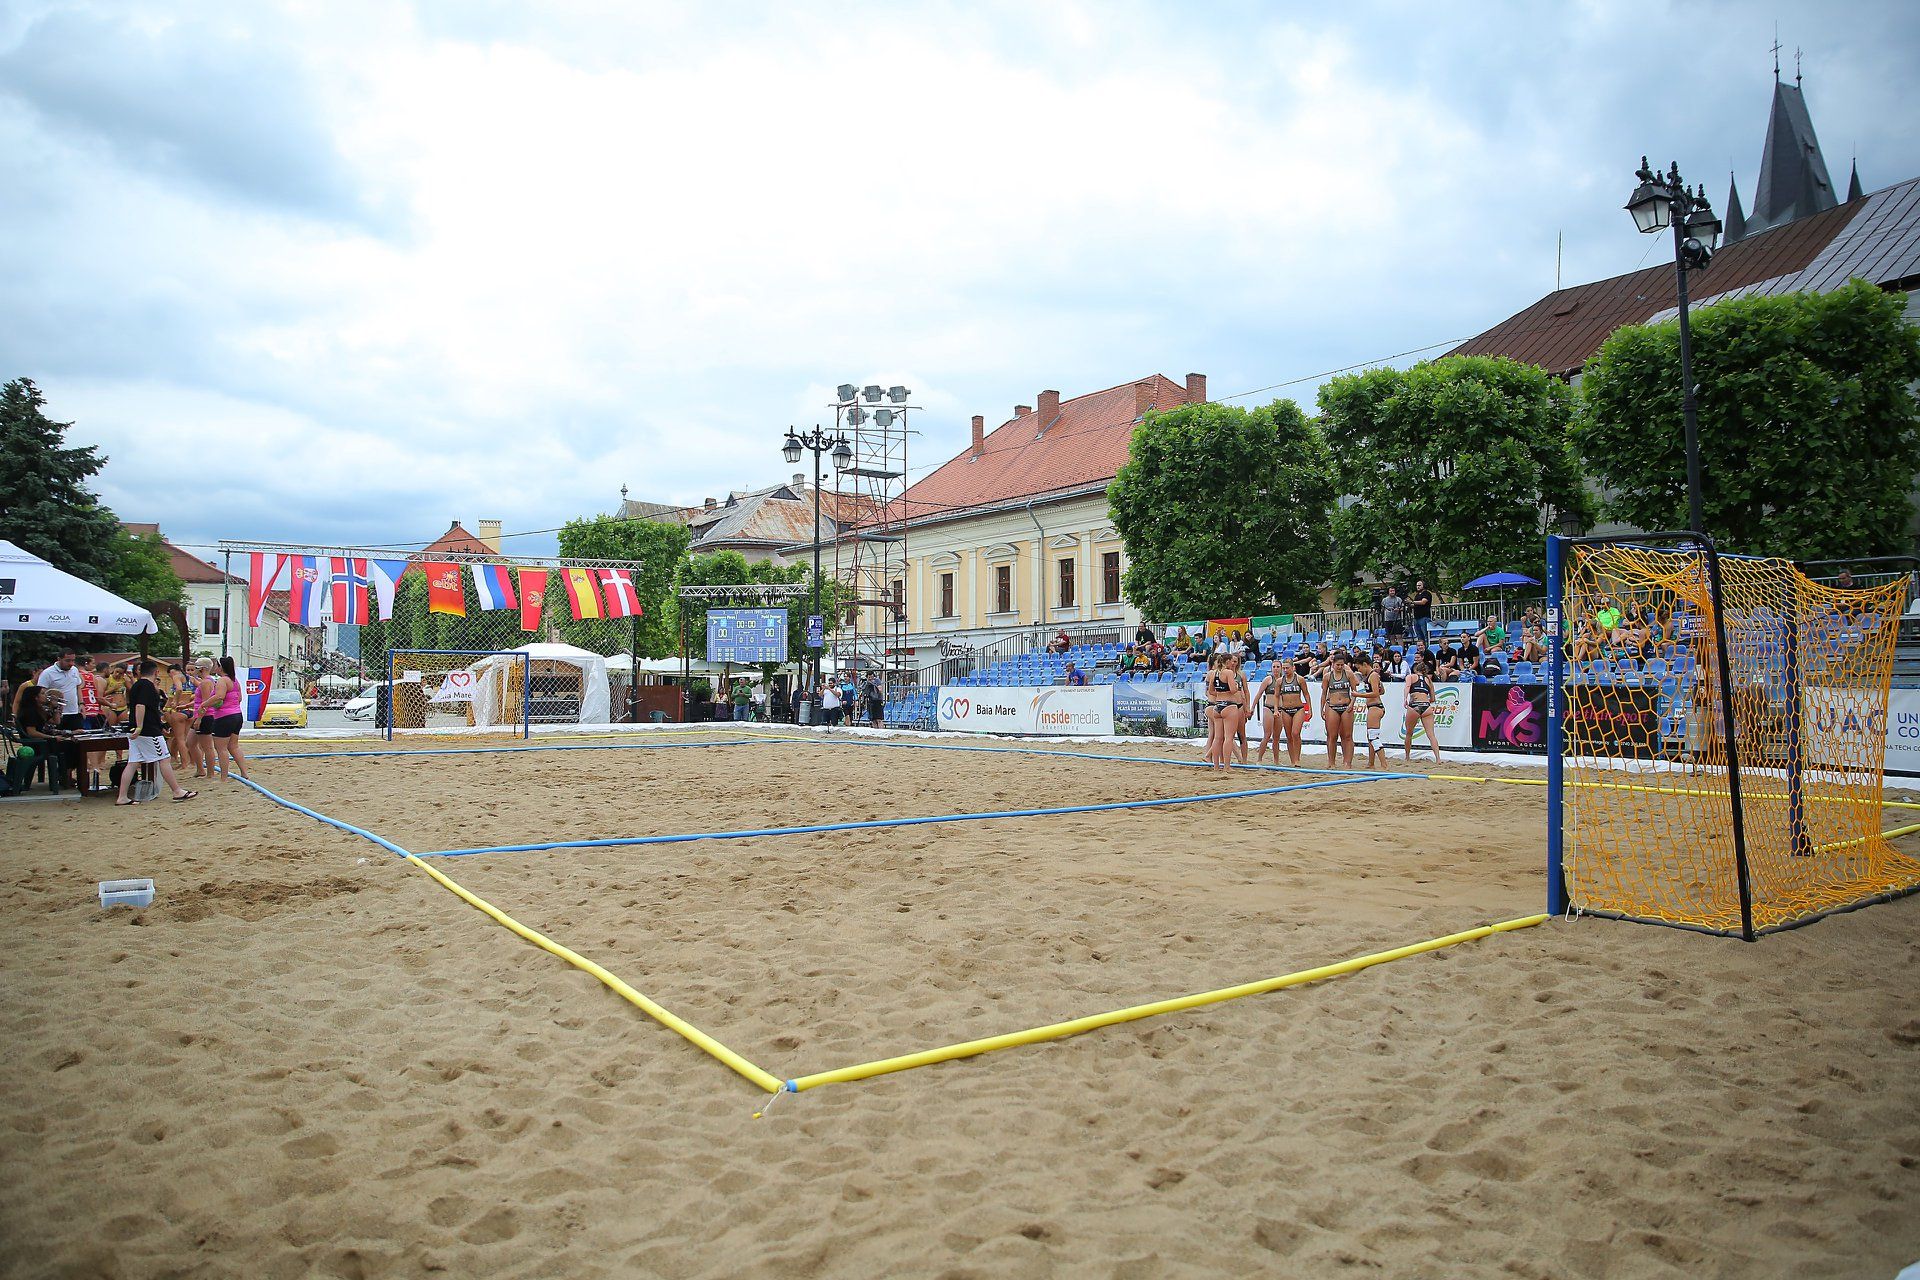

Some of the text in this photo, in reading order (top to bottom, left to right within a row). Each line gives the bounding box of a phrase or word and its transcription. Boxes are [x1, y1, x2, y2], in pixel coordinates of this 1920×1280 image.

[115, 616, 138, 624] AQUA
[88, 688, 97, 704] 8
[976, 704, 1016, 716] Baia Mare
[1041, 709, 1100, 725] insidemedia
